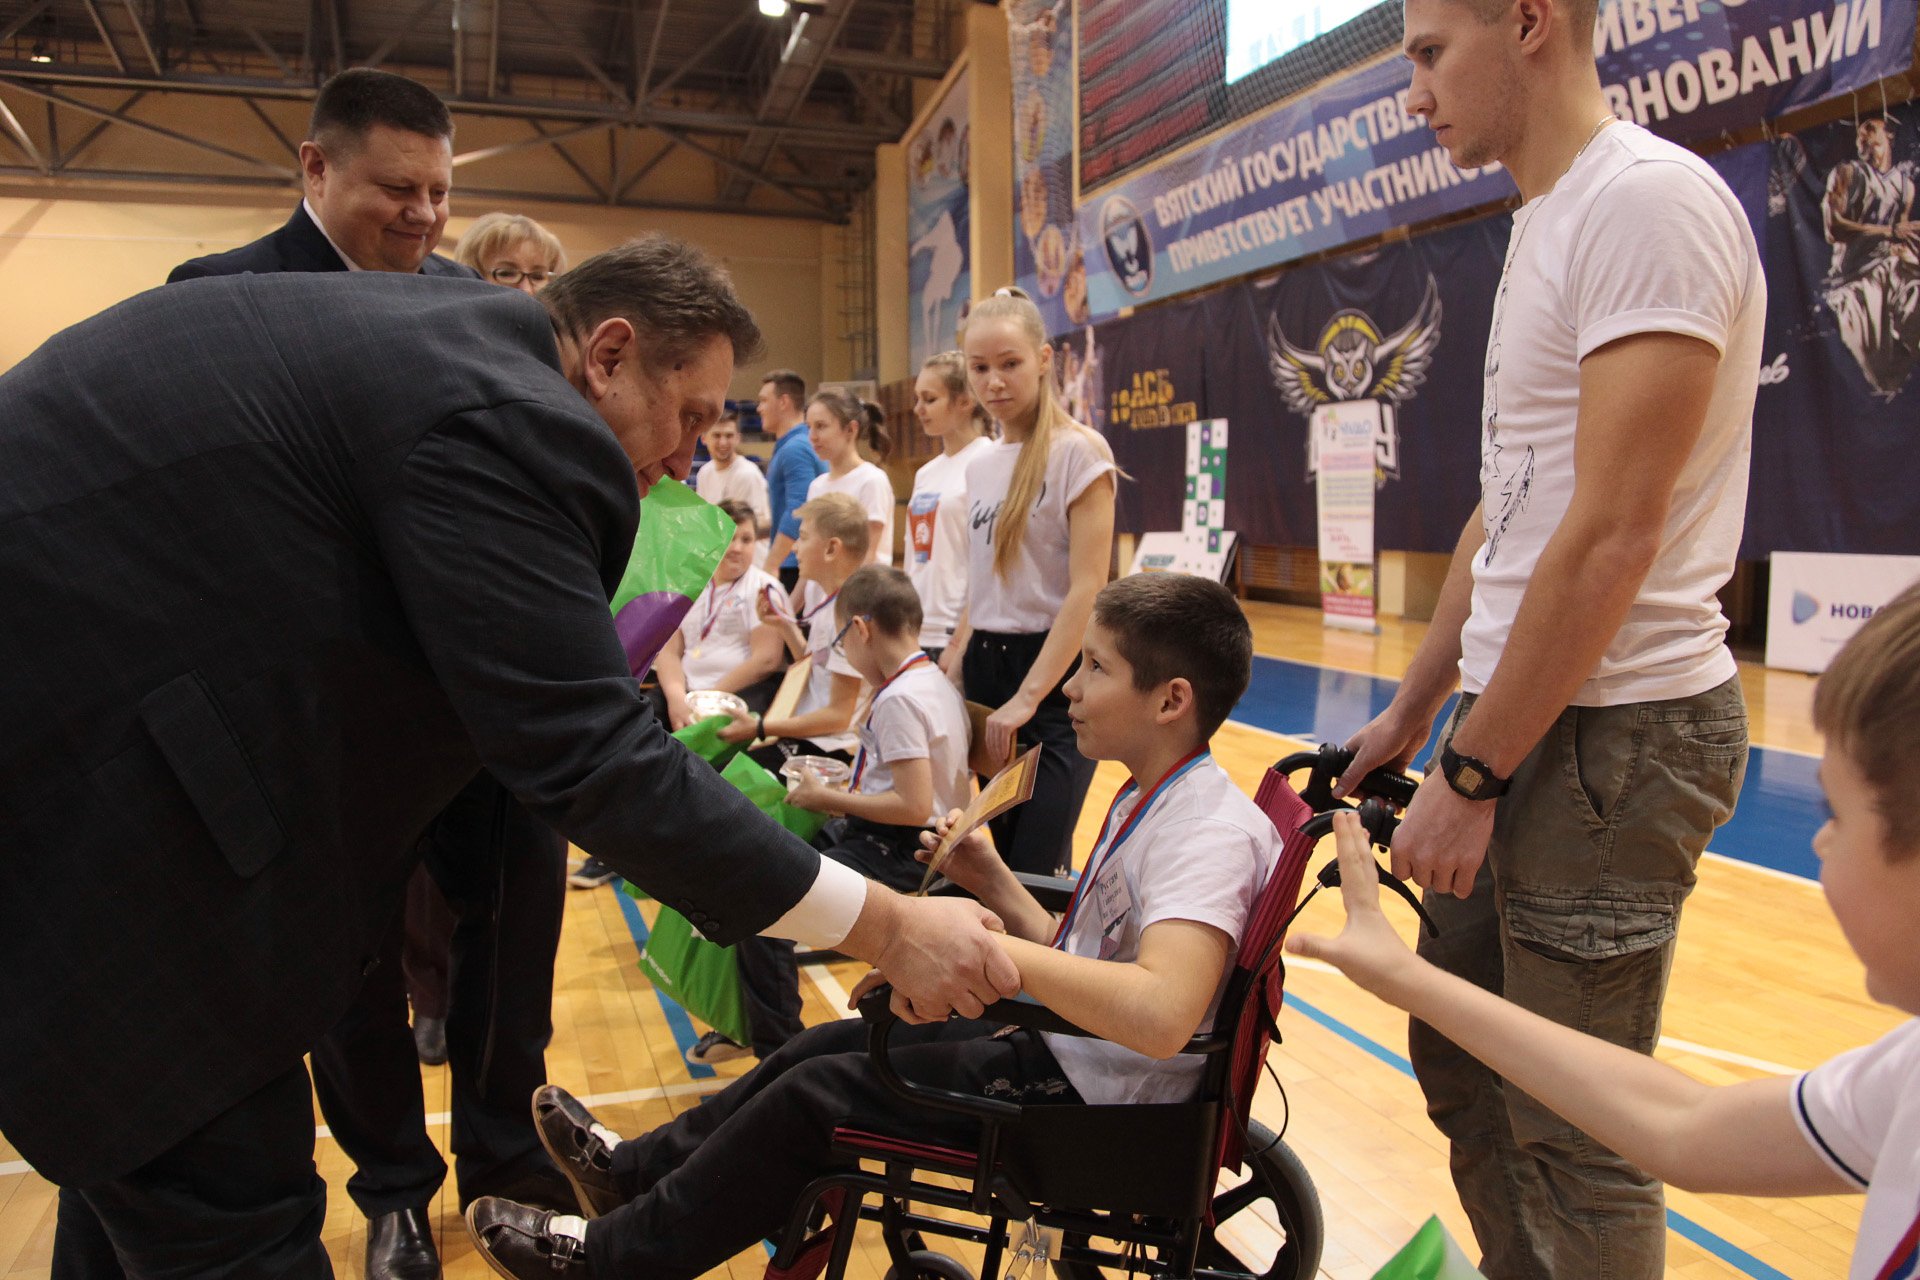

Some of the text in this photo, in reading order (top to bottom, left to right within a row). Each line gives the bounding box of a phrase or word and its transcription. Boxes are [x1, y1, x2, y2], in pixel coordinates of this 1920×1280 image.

[1153, 156, 1244, 228] ВЯТСКИЙ
[1241, 87, 1427, 193] ГОСУДАРСТВЕ
[1167, 195, 1314, 273] ПРИВЕТСТВУЕТ
[1311, 147, 1504, 227] УЧАСТНИК
[1830, 604, 1875, 619] НОВ
